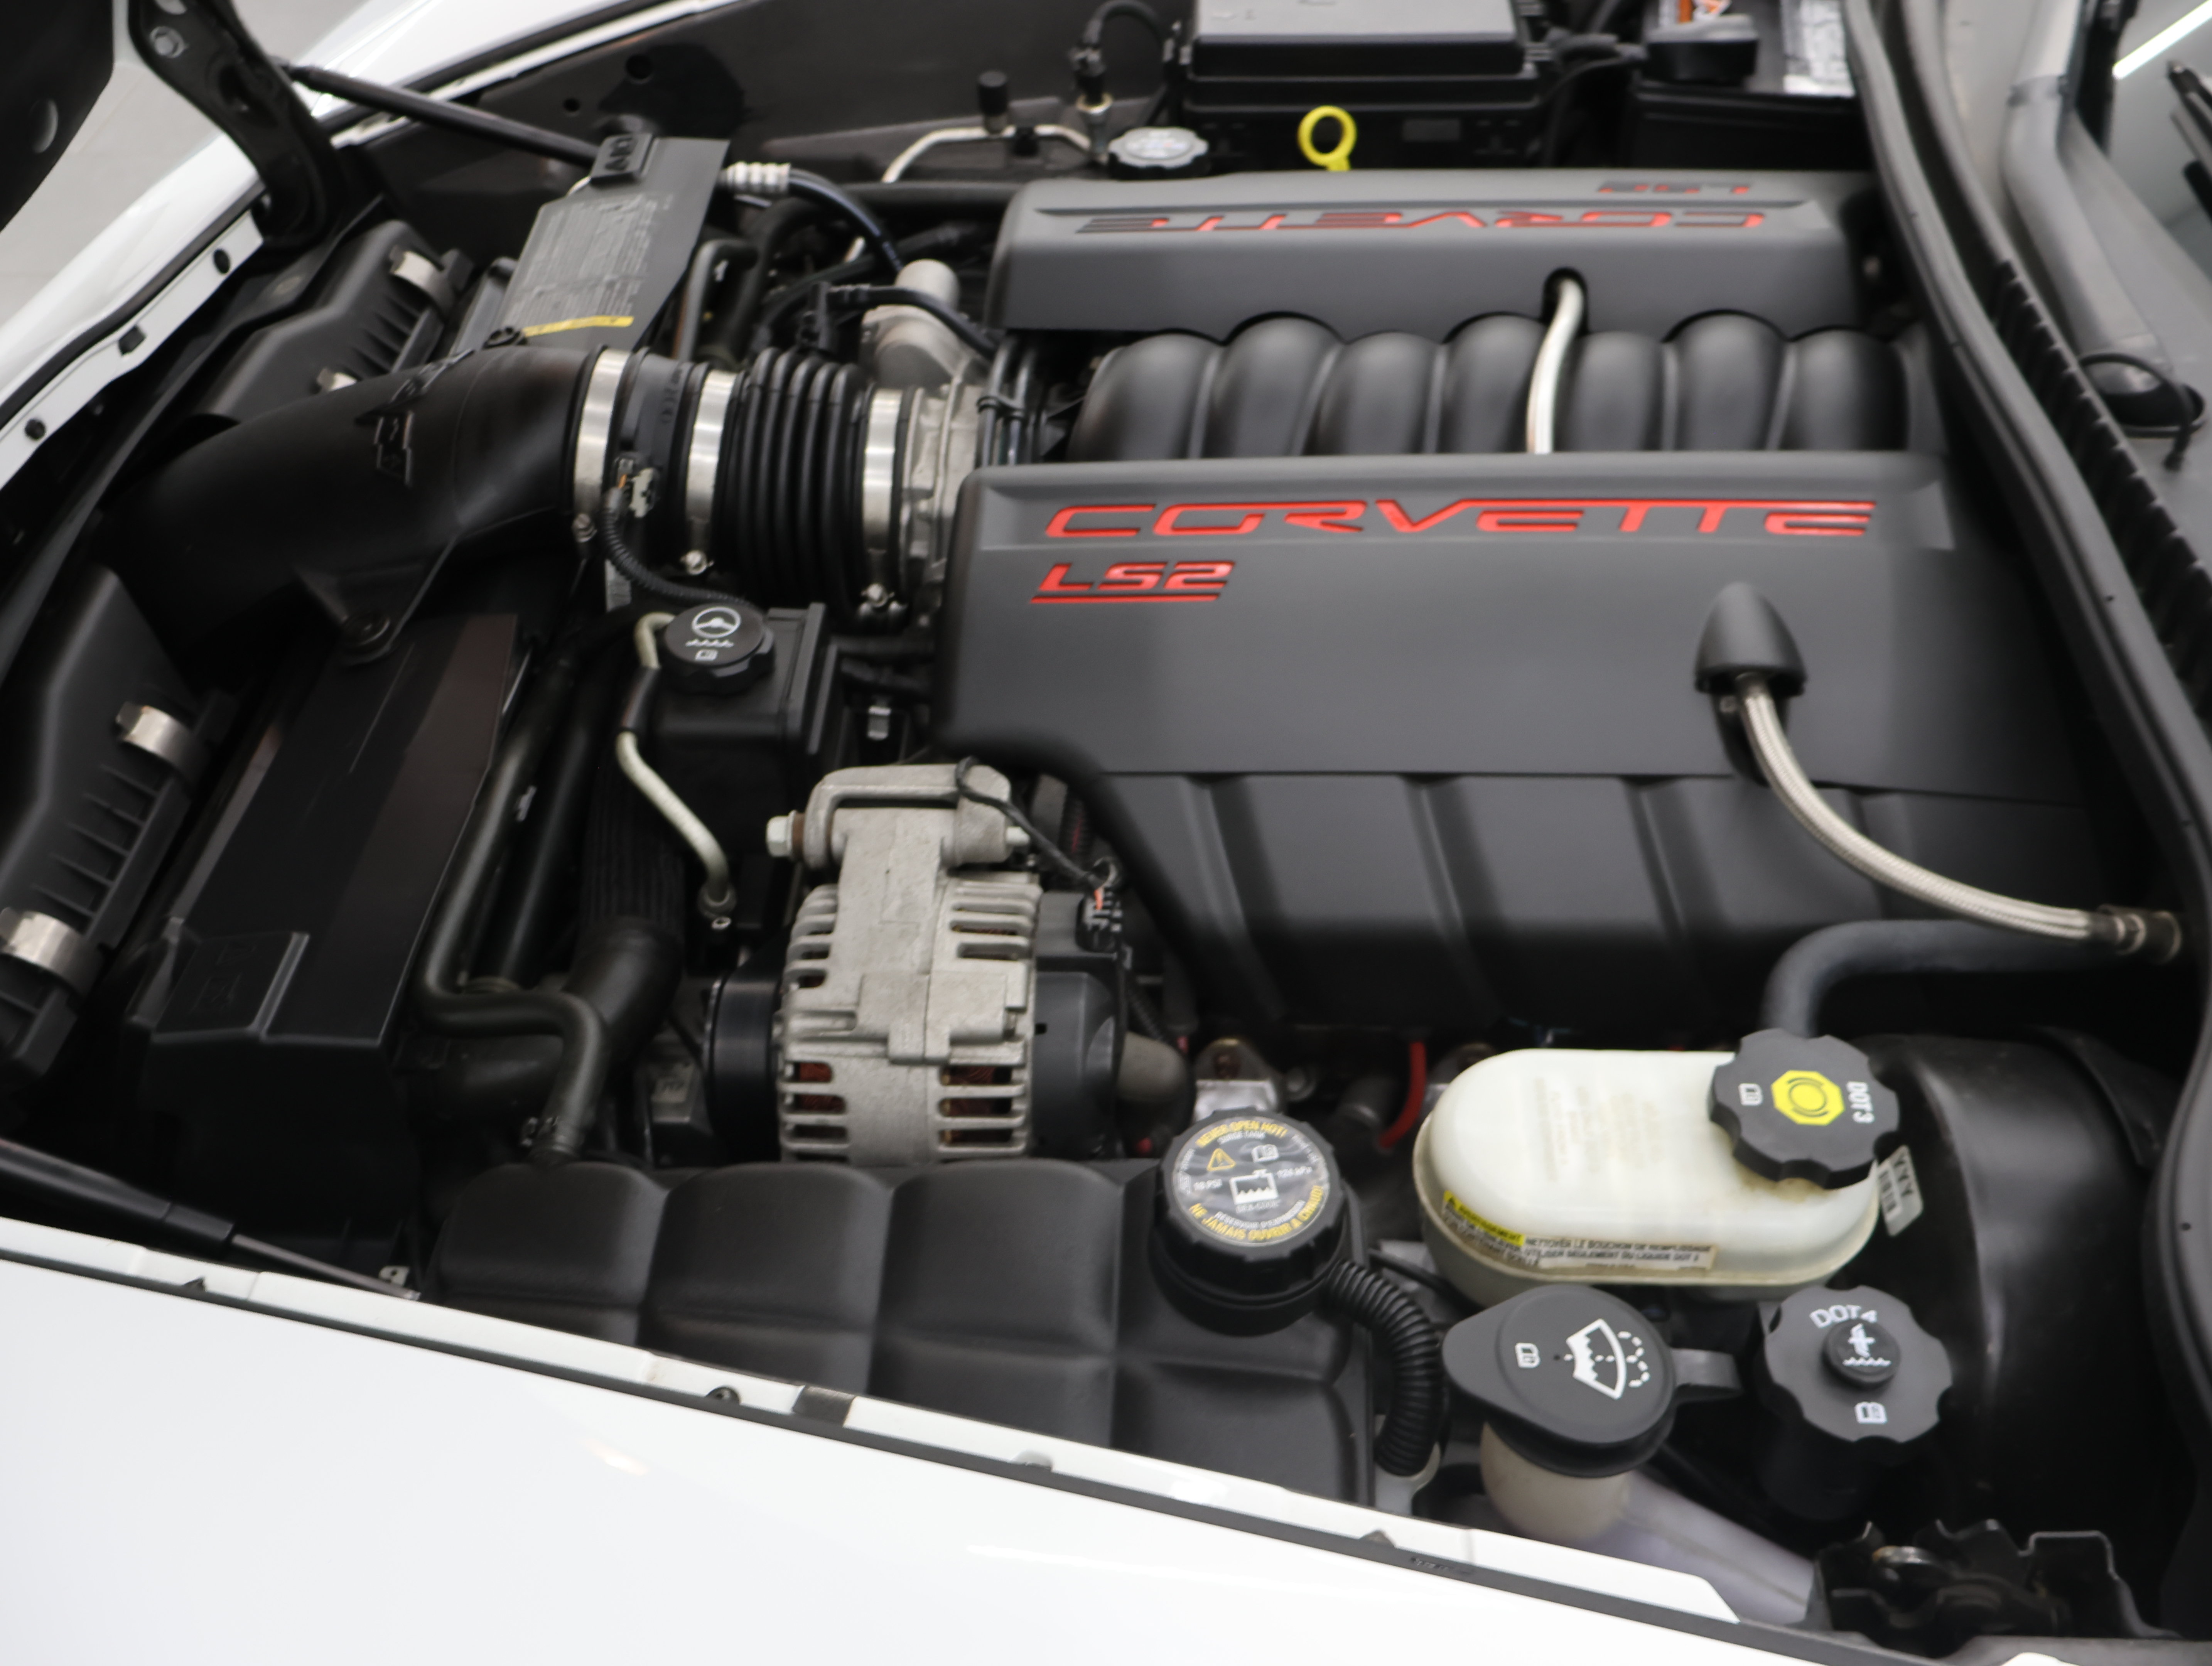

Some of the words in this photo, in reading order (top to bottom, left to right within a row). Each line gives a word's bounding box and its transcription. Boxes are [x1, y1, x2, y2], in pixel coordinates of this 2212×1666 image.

[1076, 211, 1765, 233] CORVETTE
[1045, 498, 1877, 537] CORVETTE
[1037, 560, 1236, 592] LS2
[1846, 1081, 1873, 1113] DOT
[1852, 1110, 1875, 1124] 3
[1196, 1124, 1228, 1148] NEVER
[1228, 1120, 1261, 1133] OPEN
[1261, 1122, 1288, 1139] HOT!
[1189, 1202, 1208, 1219] NE
[1201, 1216, 1247, 1241] JAMAIS
[1809, 1304, 1861, 1329] DOT
[1860, 1310, 1878, 1323] 4
